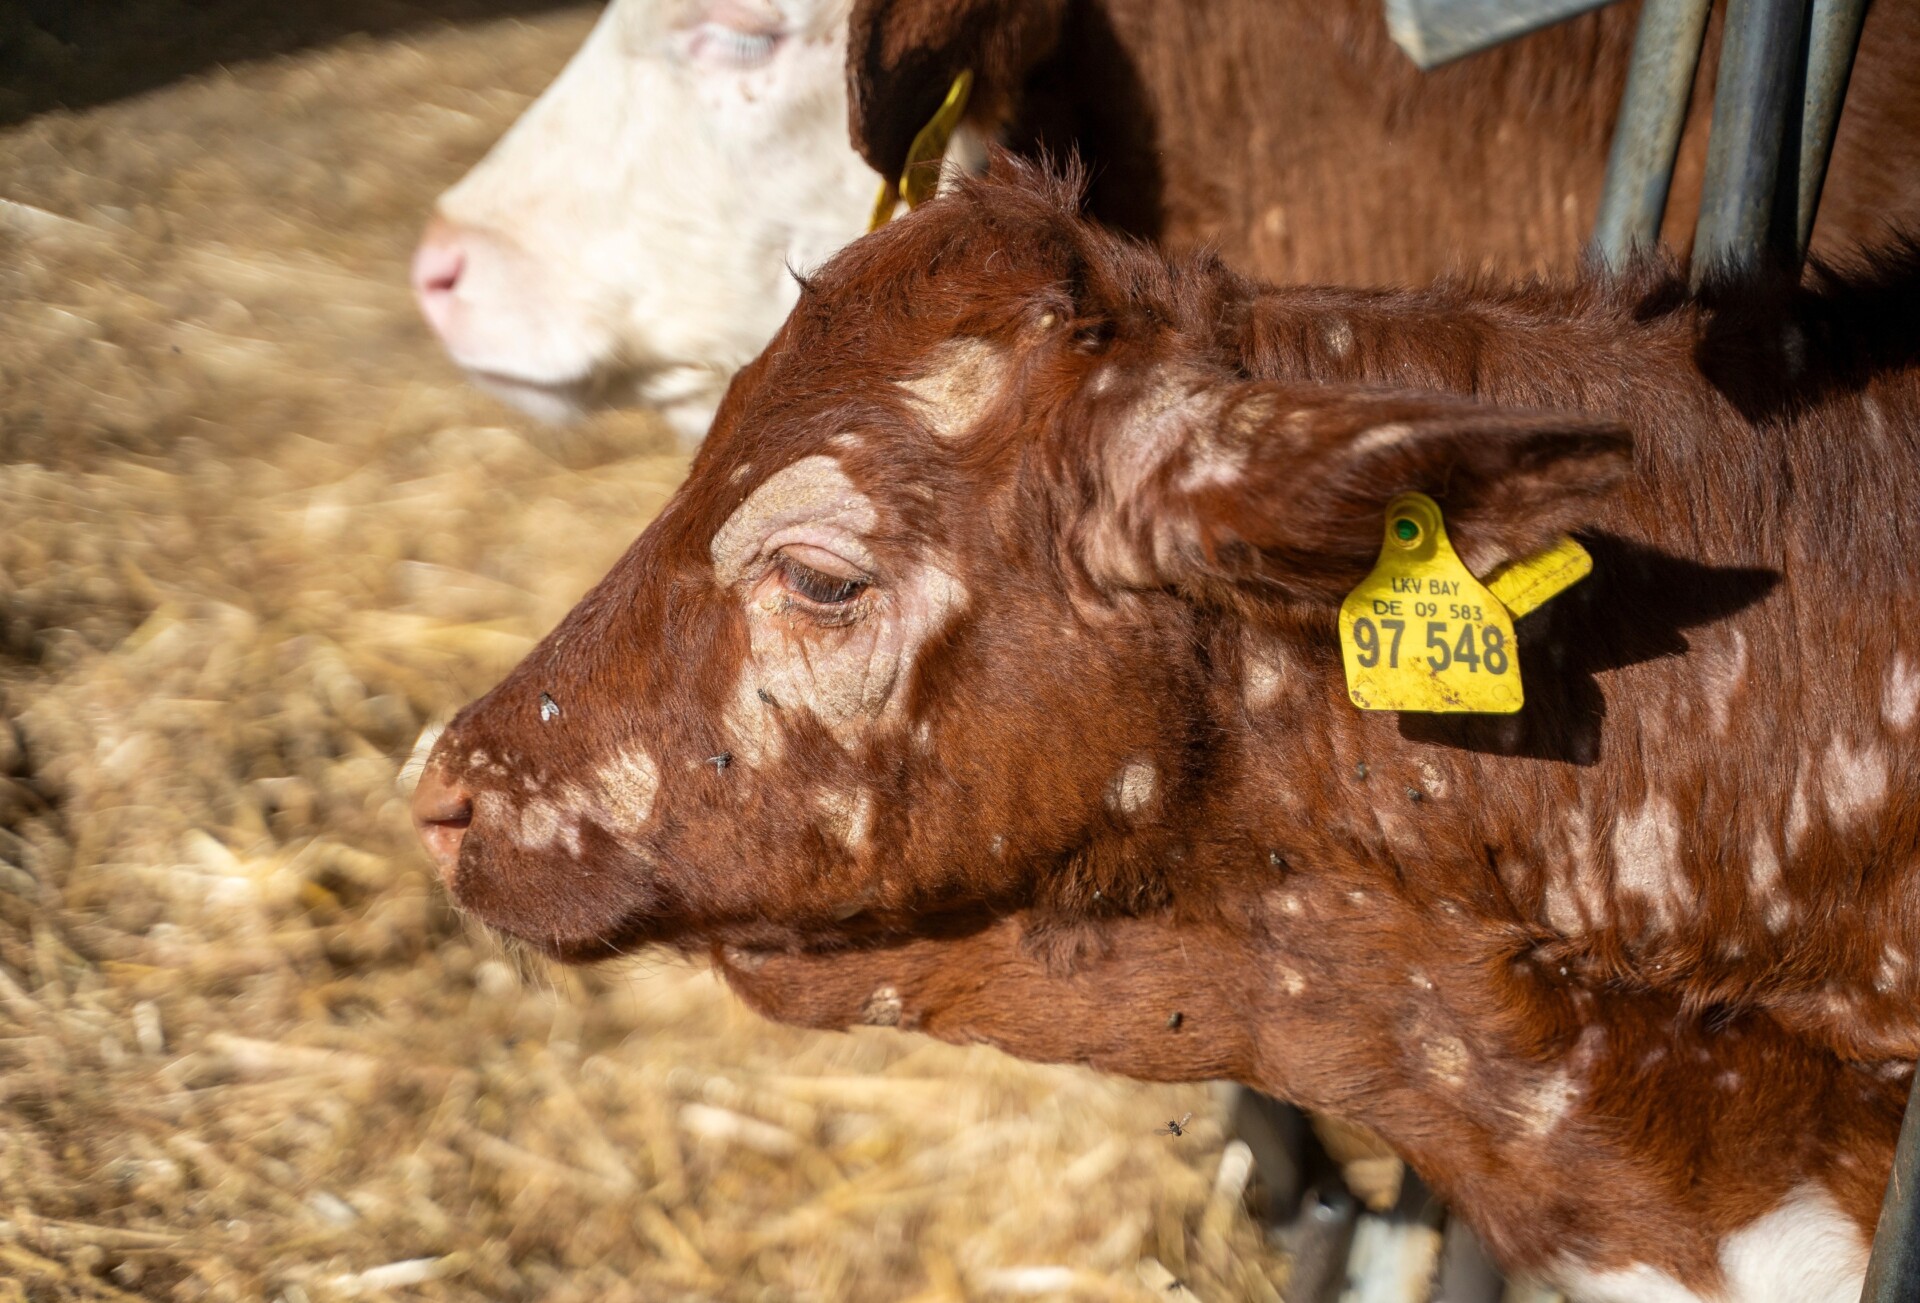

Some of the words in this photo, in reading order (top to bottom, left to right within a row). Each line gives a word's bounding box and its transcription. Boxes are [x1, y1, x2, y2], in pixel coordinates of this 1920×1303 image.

[1392, 577, 1421, 593] LKV
[1430, 579, 1460, 596] BAY
[1373, 600, 1404, 616] DE
[1415, 602, 1437, 618] 09
[1450, 605, 1483, 621] 583
[1353, 617, 1405, 669] 97
[1426, 621, 1509, 675] 548
